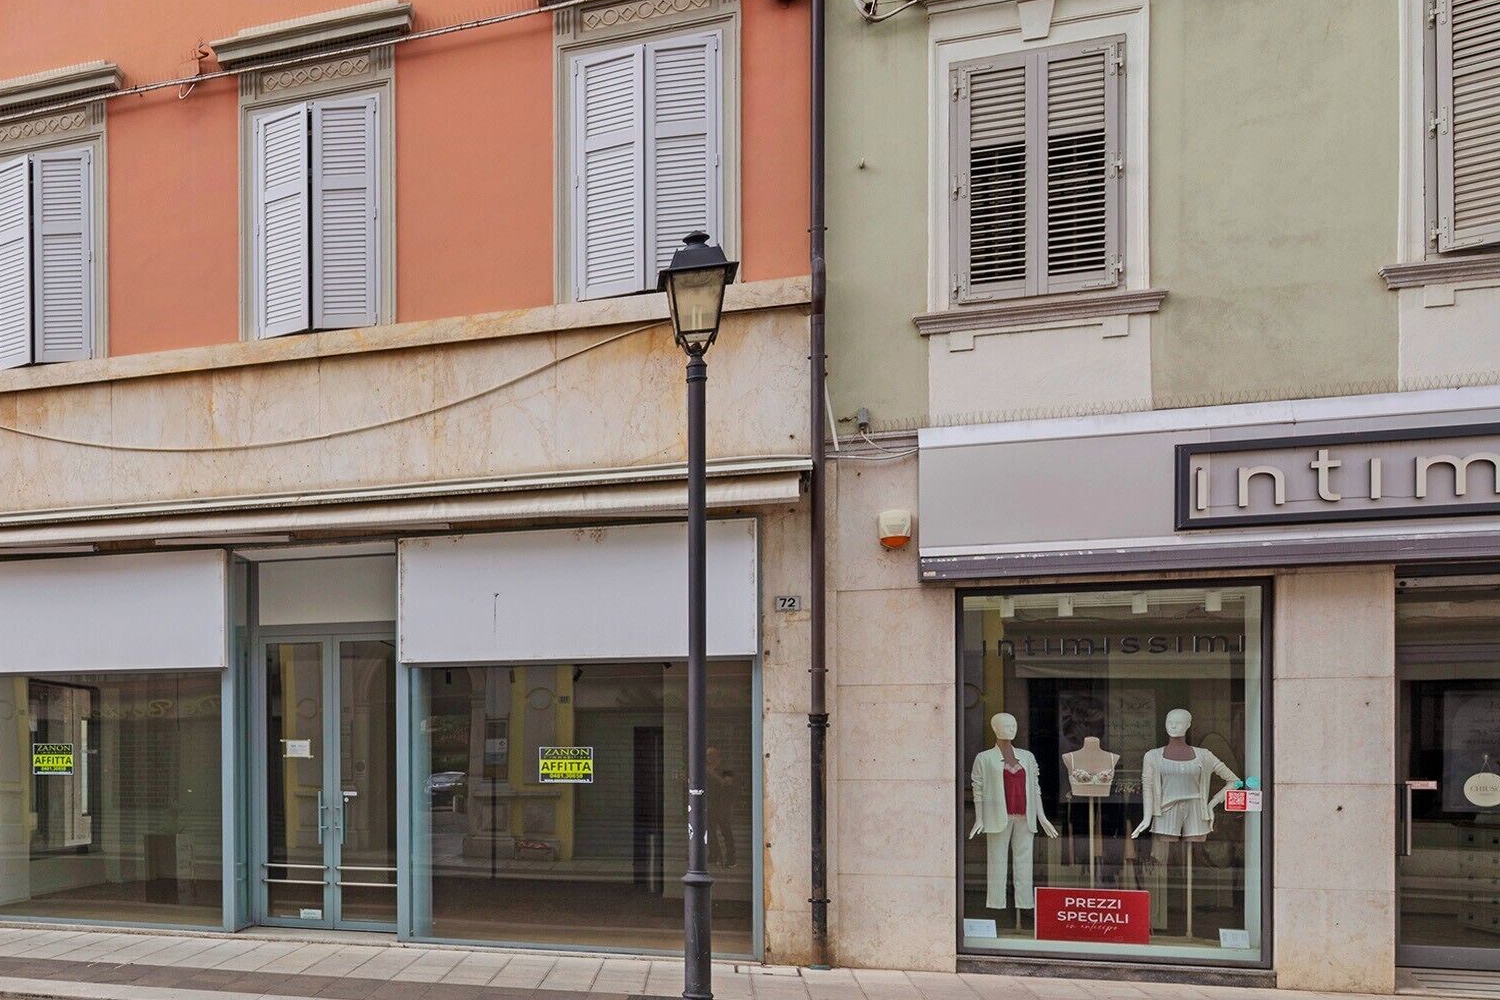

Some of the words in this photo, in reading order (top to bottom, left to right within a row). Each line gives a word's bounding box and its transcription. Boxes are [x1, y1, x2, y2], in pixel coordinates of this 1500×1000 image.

[1196, 449, 1500, 510] intim
[779, 597, 796, 608] 72
[544, 748, 590, 756] ZANON
[35, 756, 73, 765] AFFITTA
[541, 761, 591, 771] AFFITTA
[1065, 897, 1121, 910] PREZZI
[1057, 911, 1129, 924] SPECIALI
